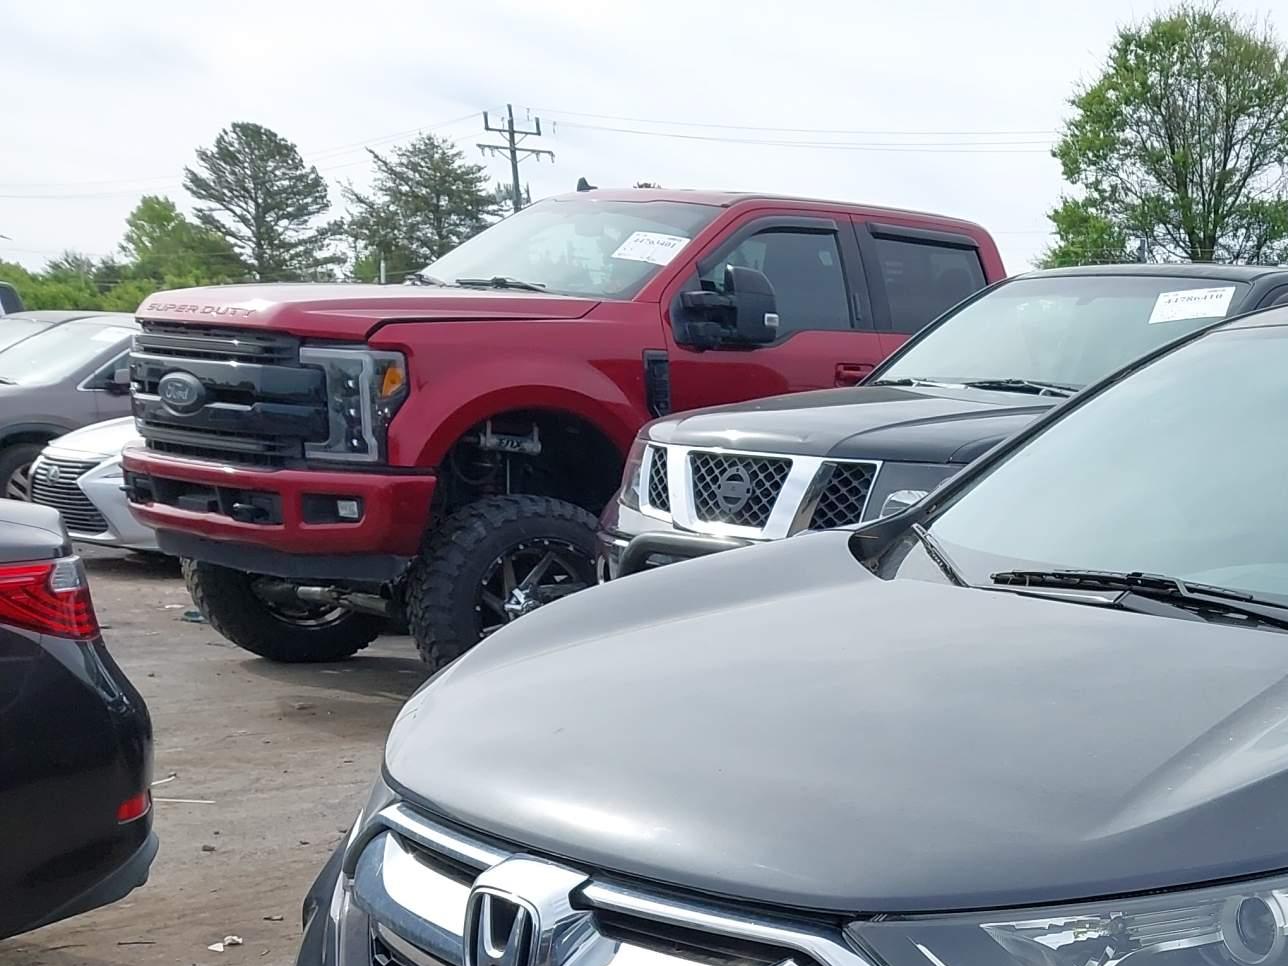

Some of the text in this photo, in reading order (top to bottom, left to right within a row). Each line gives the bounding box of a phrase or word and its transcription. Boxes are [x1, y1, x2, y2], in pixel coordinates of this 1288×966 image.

[146, 302, 257, 318] SUPER DUTY
[165, 381, 189, 400] Ford
